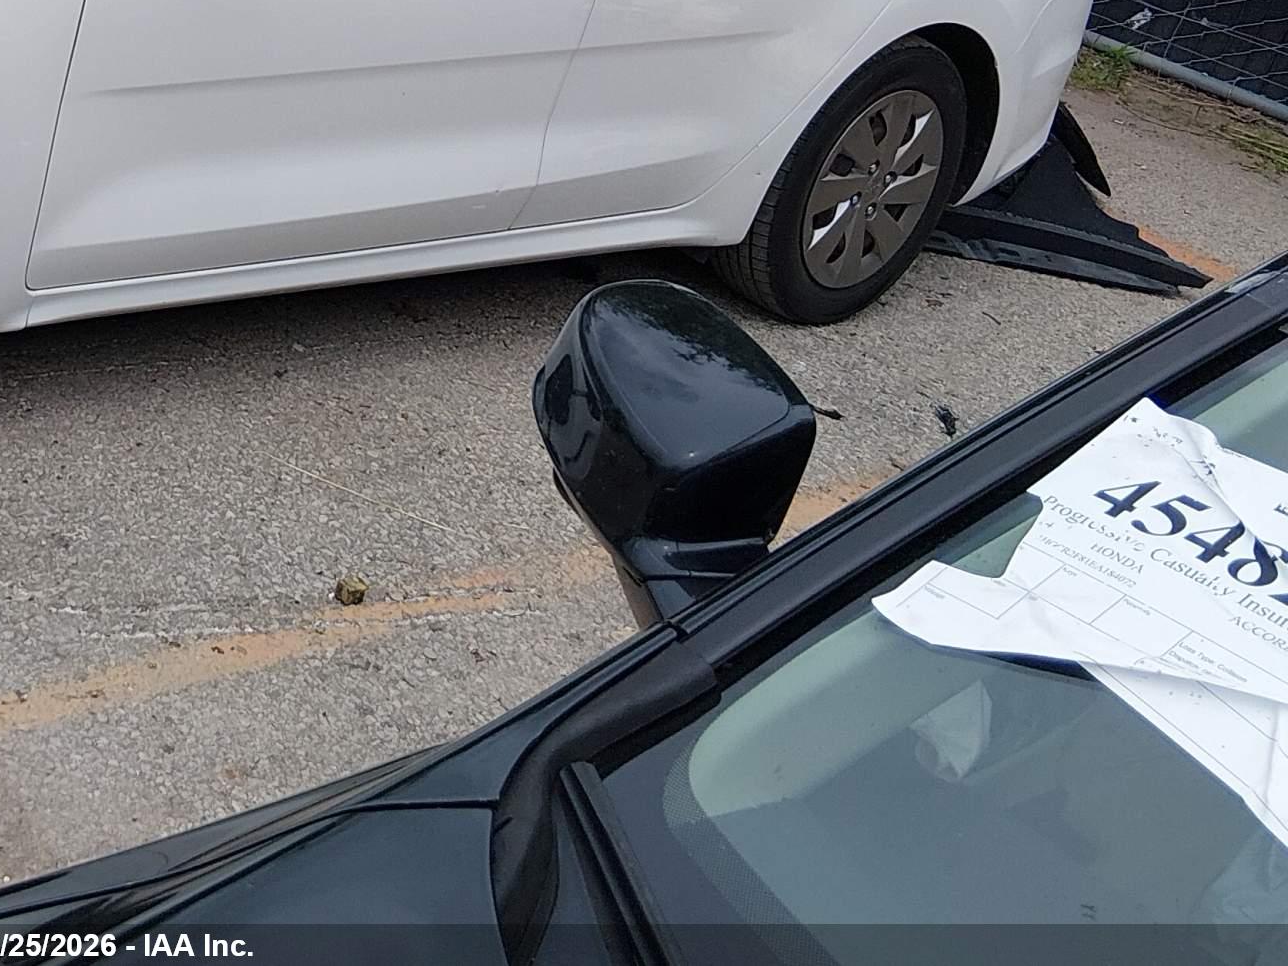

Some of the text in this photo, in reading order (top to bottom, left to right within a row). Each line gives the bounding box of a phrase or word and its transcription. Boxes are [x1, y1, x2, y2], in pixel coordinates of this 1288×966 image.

[1090, 542, 1288, 651] HONDA ACCOR
[1094, 481, 1288, 607] 4548
